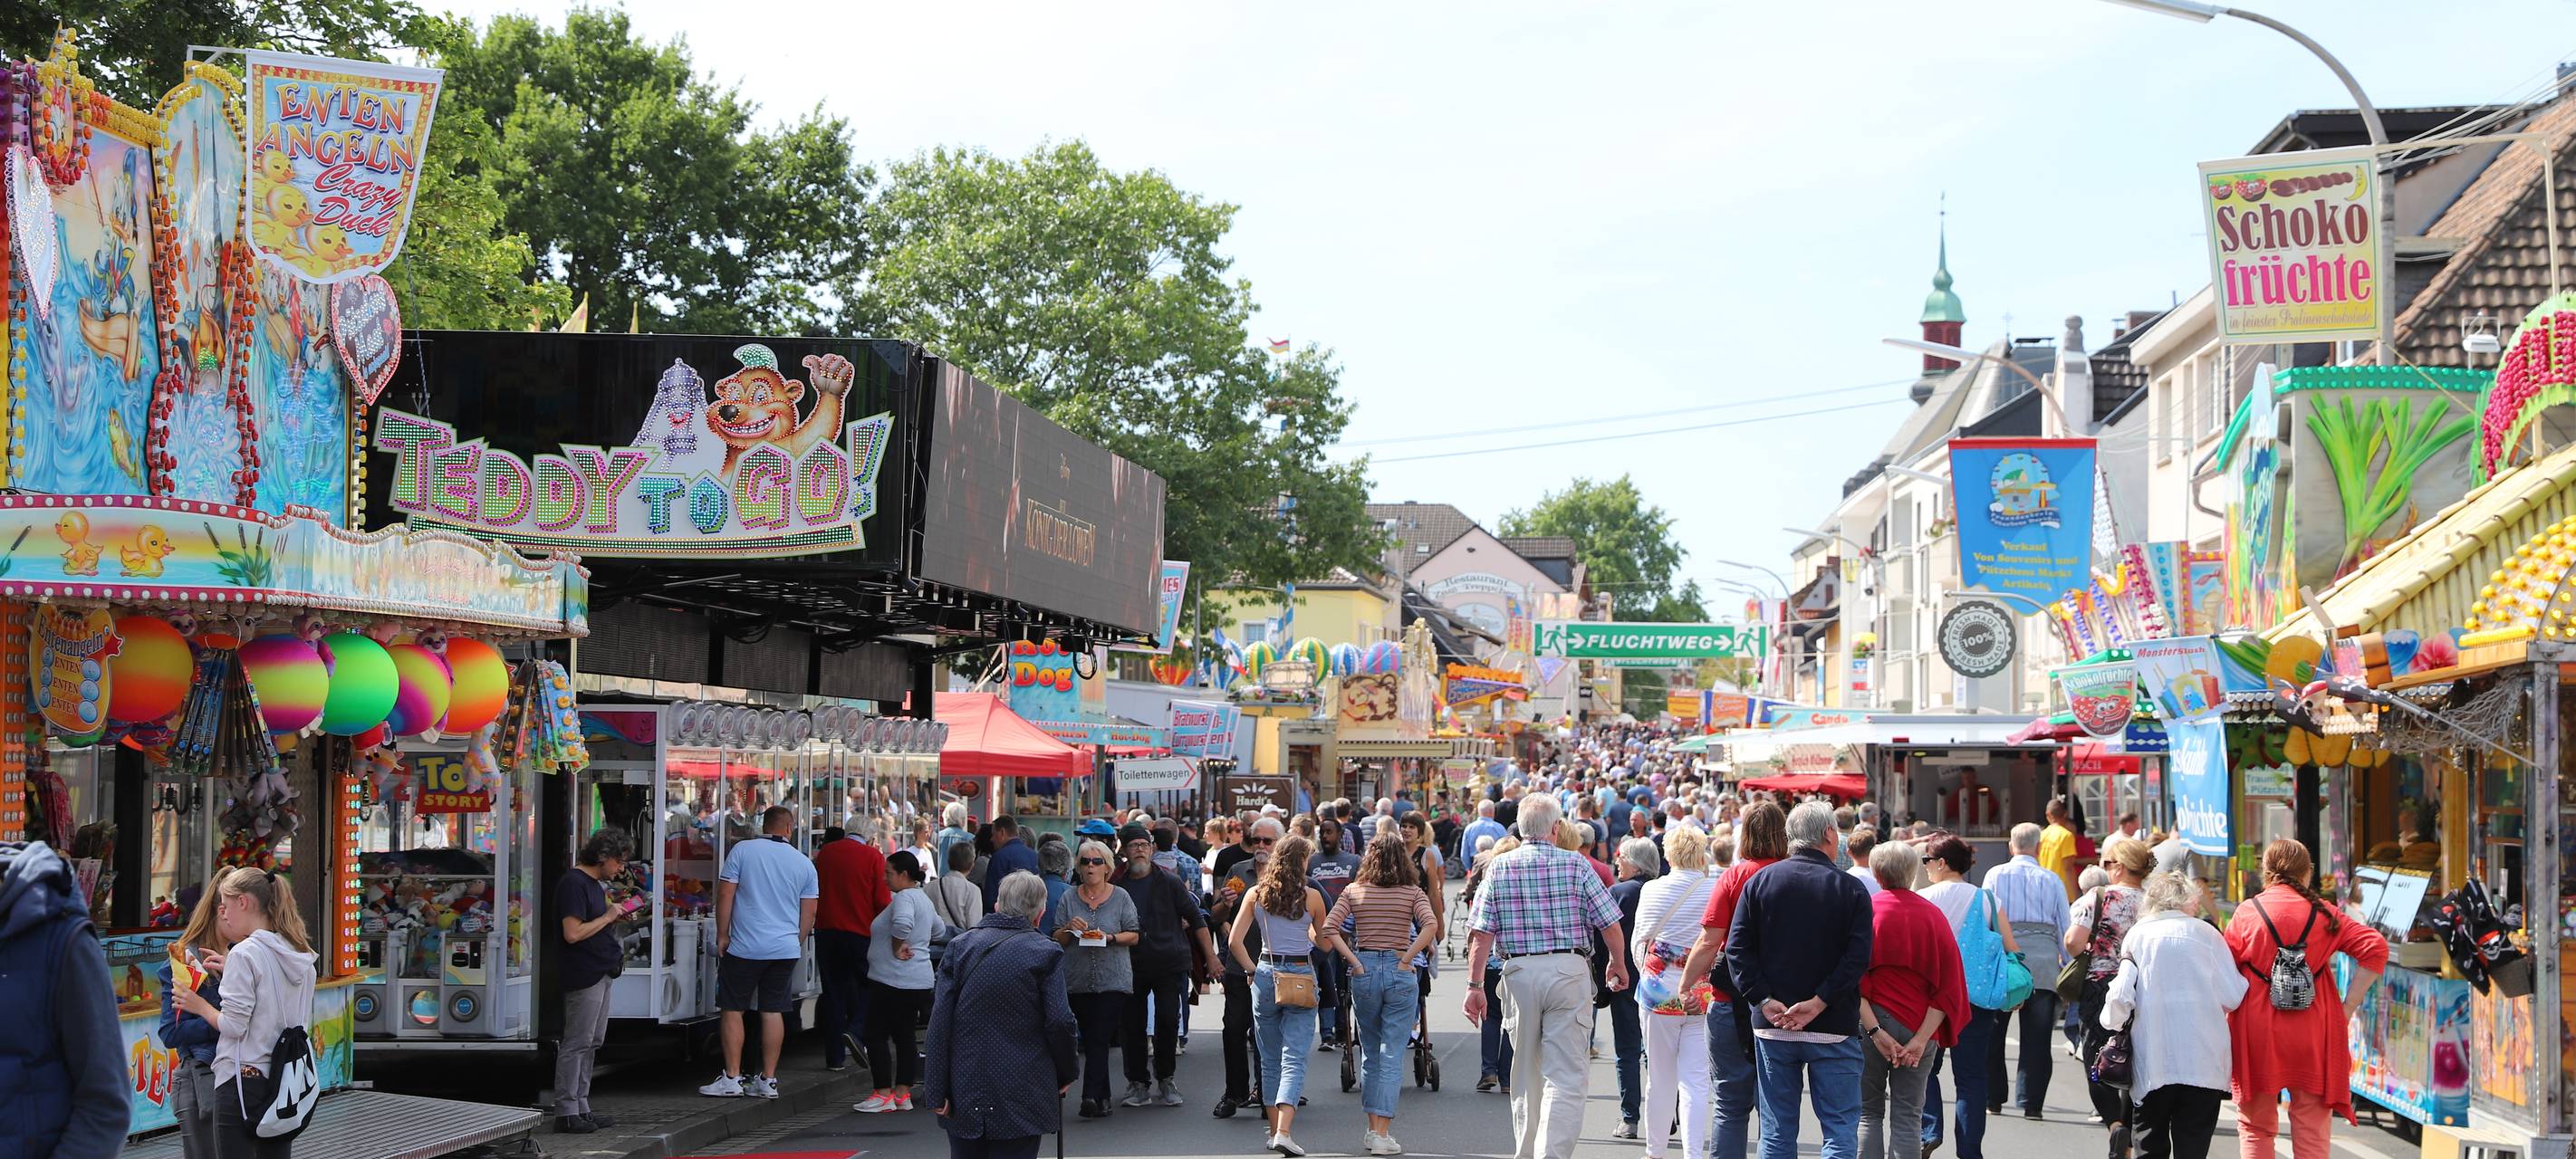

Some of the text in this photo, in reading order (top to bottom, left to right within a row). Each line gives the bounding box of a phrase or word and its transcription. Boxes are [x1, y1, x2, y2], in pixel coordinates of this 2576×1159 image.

[276, 82, 406, 133] ENTEN
[255, 122, 414, 173] ANGELN
[313, 163, 403, 214] Crazy
[312, 196, 397, 236] Duck
[2216, 199, 2369, 253] Schoko
[2223, 254, 2370, 307] früchte
[379, 413, 889, 534] TEDDY TO GO!
[2003, 541, 2046, 551] Verkauf
[1974, 552, 2078, 565] Von Souvenirs und
[1445, 574, 1507, 588] Restaurant
[1587, 634, 1713, 649] FLUCHTWEG
[1962, 631, 1993, 647] 100%
[55, 657, 81, 674] ENTEN
[53, 676, 80, 694] ENTEN
[1014, 662, 1072, 691] Dog
[52, 696, 78, 715] ENTEN
[1174, 710, 1209, 727] Bratwurst
[1119, 767, 1190, 781] Toilettenwagen
[424, 794, 484, 809] STORY
[1235, 795, 1273, 806] Hardt's
